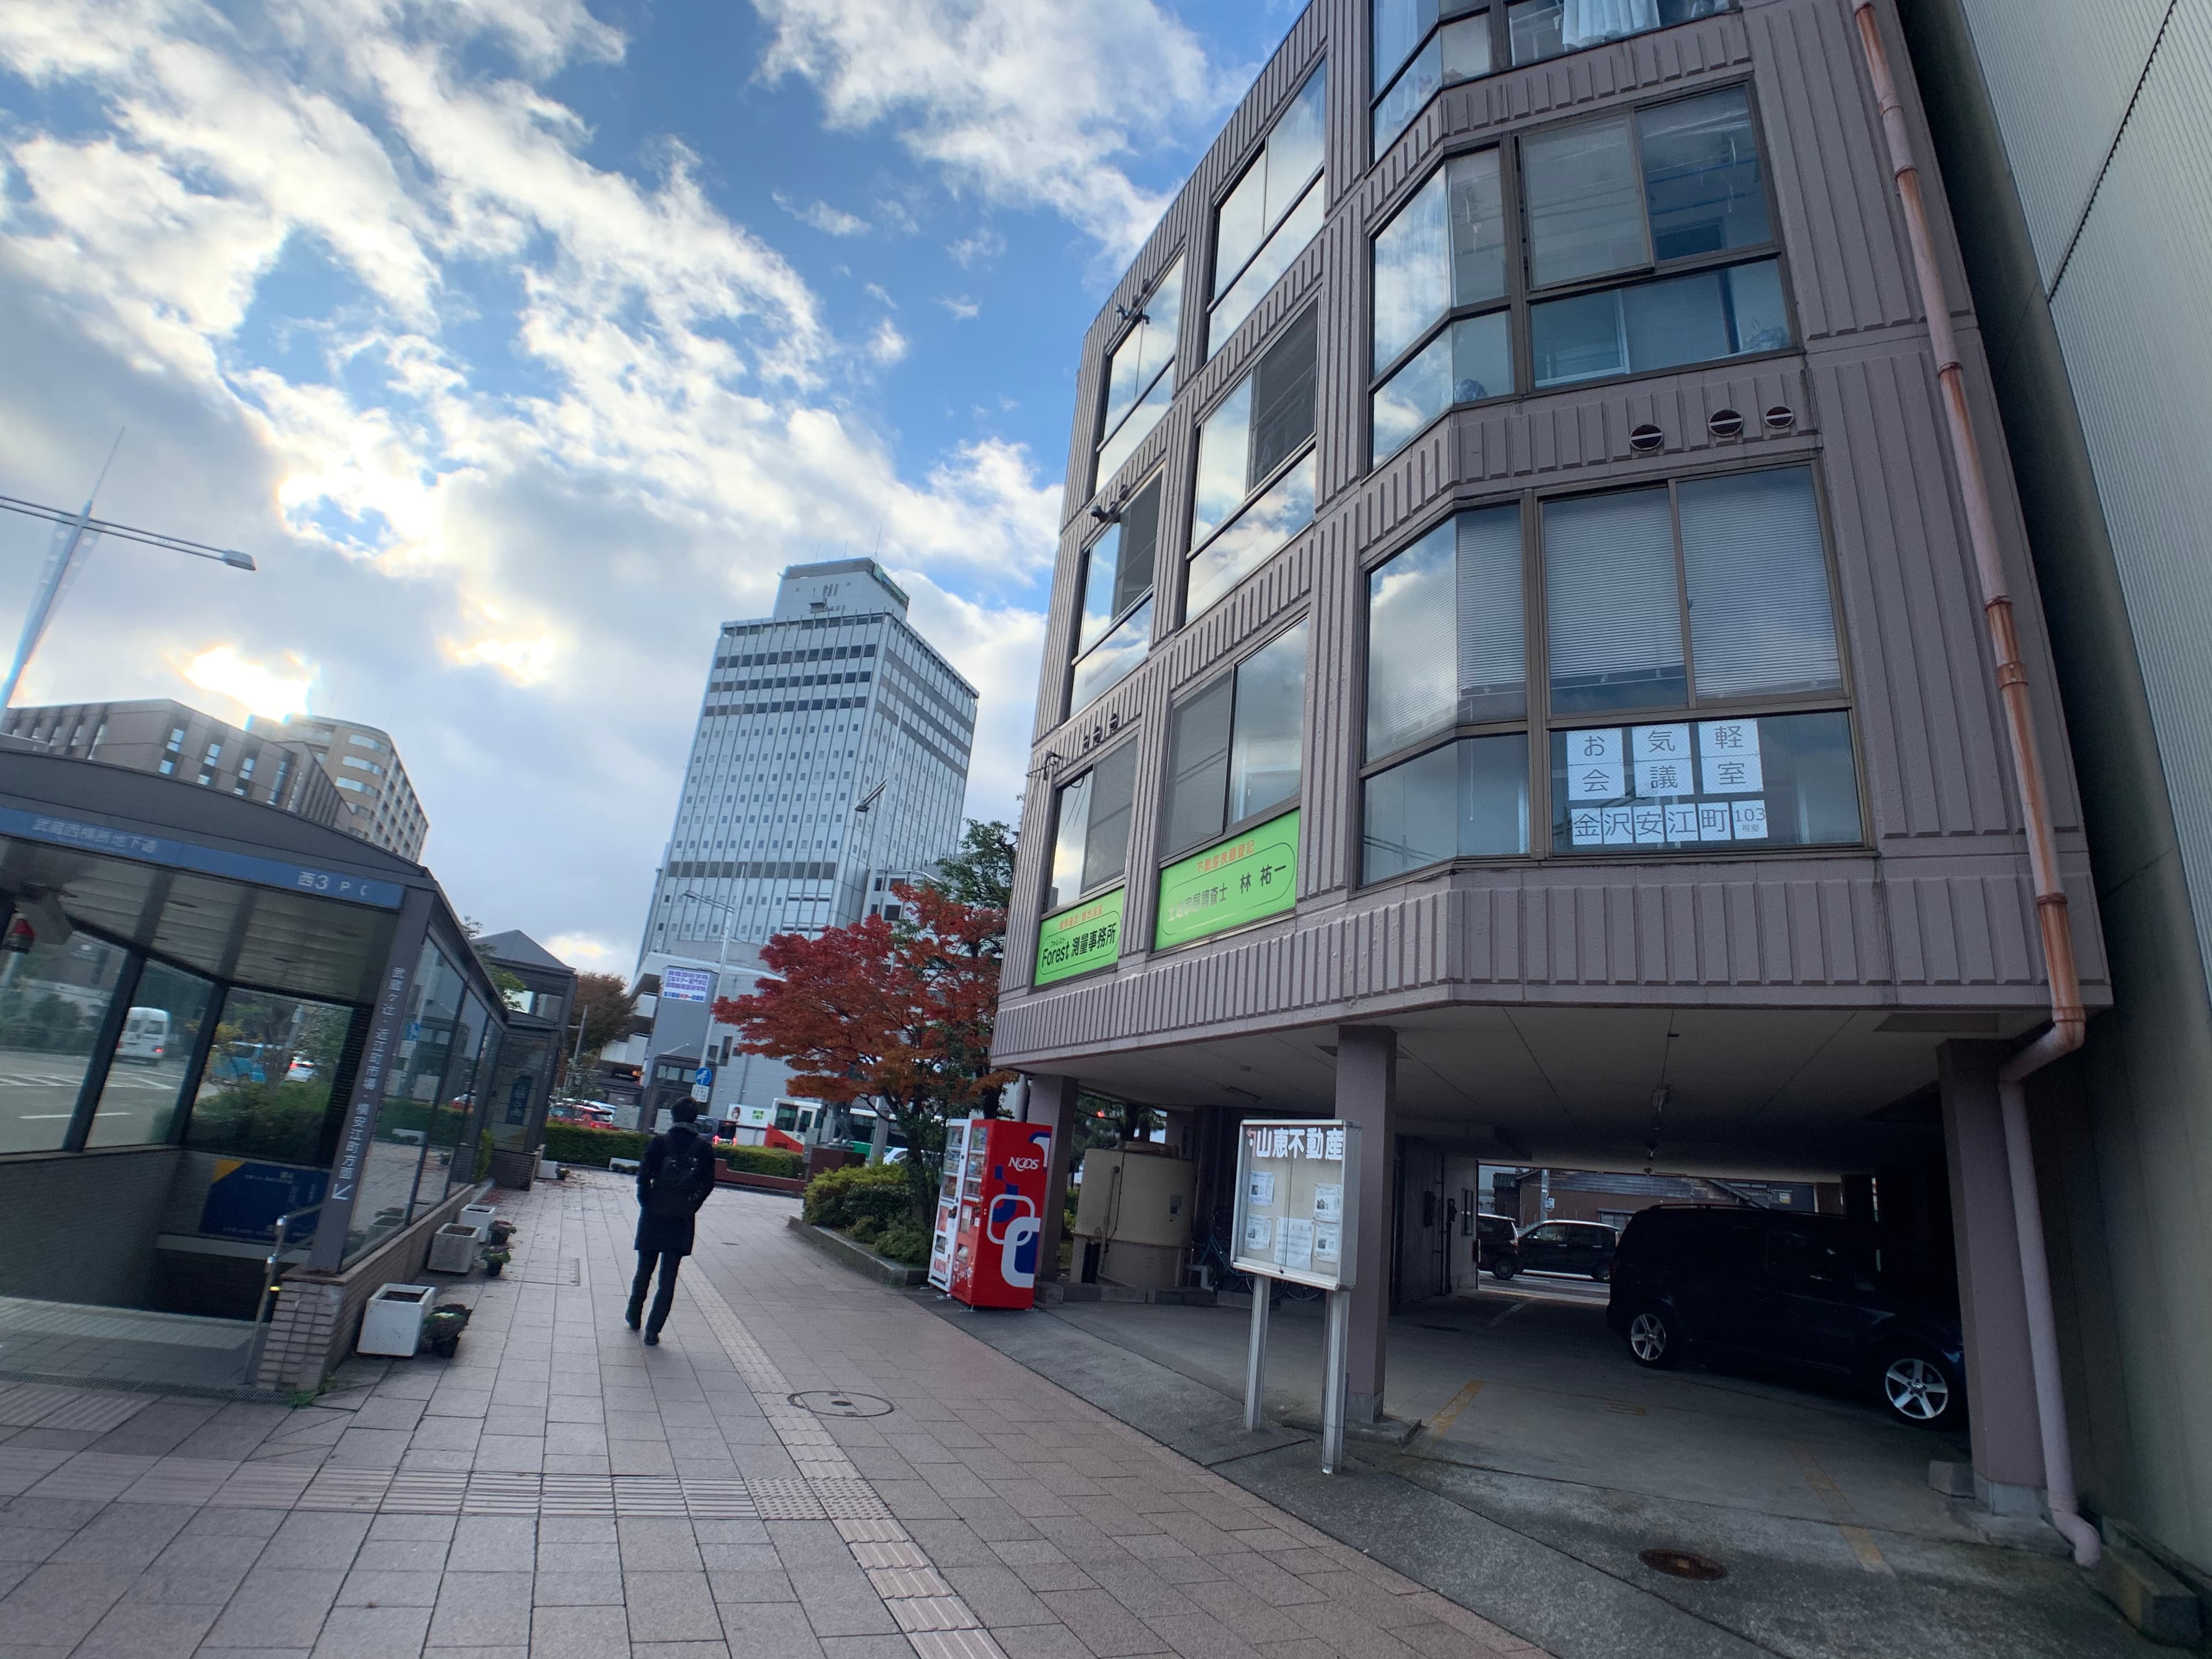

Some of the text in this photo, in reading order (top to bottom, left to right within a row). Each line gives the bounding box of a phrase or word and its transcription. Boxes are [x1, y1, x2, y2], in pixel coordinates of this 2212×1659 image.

[1584, 725, 1744, 756] お気軽
[1582, 762, 1746, 792] 会議室
[1573, 808, 1765, 836] 金沢安江町 103
[1240, 872, 1252, 894] 林
[1260, 864, 1286, 887] 祐一
[1041, 922, 1116, 968] Forest 測量事務所
